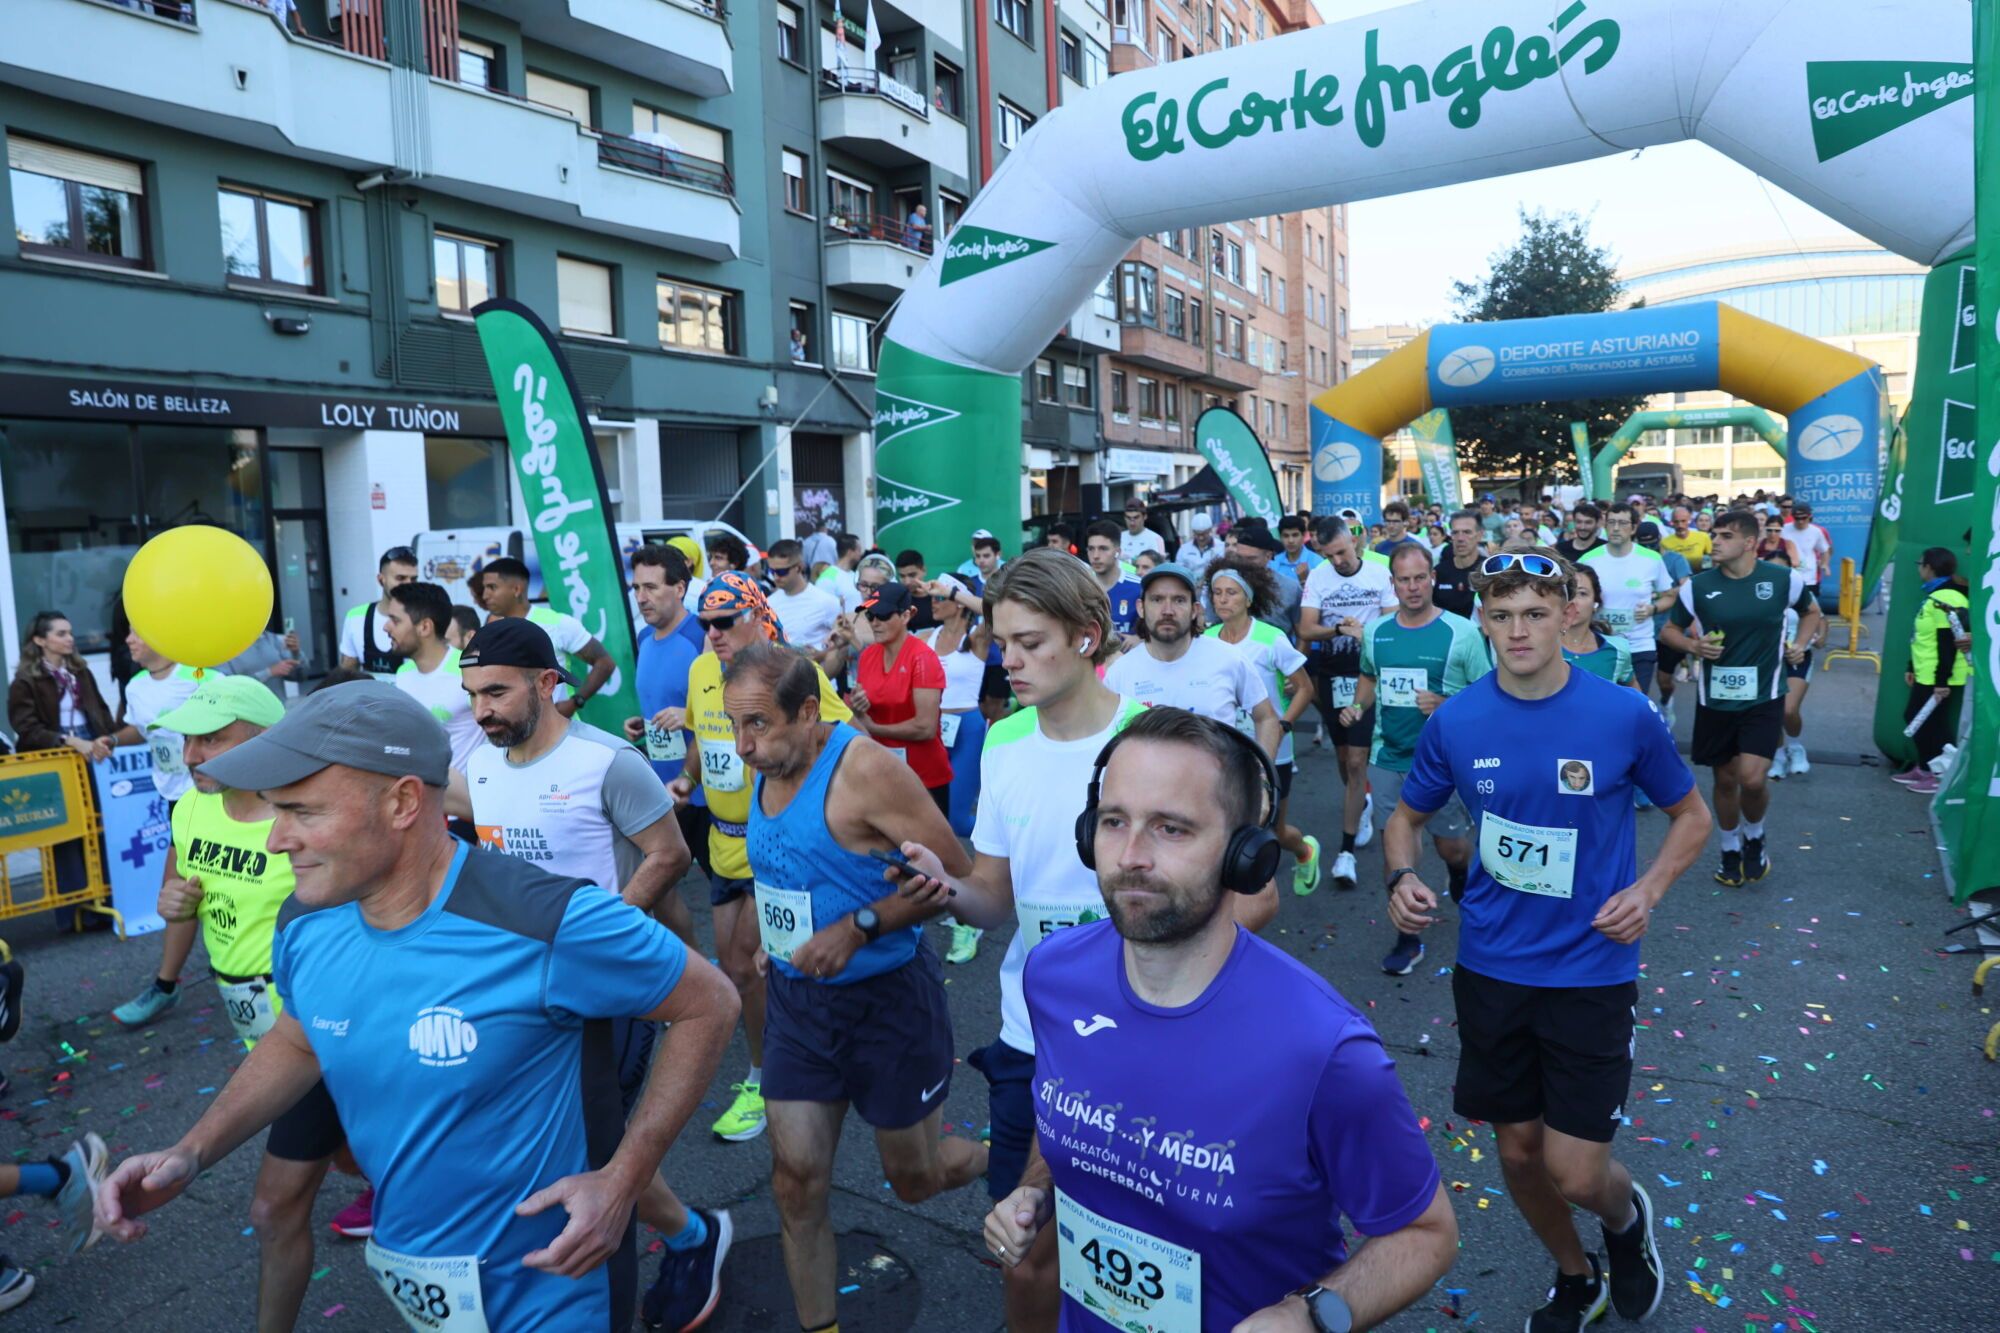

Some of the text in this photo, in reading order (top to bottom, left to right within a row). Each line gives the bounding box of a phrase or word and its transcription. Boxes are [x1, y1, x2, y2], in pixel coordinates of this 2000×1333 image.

[1121, 0, 1621, 162] El Corte Inglés
[1812, 69, 1974, 120] El Corte Inglé
[956, 241, 982, 258] Corte
[982, 236, 1030, 260] Inglés
[1500, 330, 1700, 362] DEPORTE ASTURIANO
[1551, 364, 1569, 374] DEL
[1628, 358, 1641, 369] DE
[1644, 353, 1696, 367] ASTURIAS
[69, 388, 231, 414] SALÓN DE BELLEZA
[321, 402, 460, 431] LOLY TUÑON
[1794, 473, 1873, 489] DEPORTE
[1388, 677, 1415, 691] 471
[1718, 674, 1747, 687] 498
[648, 730, 672, 744] 554
[703, 751, 731, 771] 312
[1472, 757, 1501, 769] JAKO
[1476, 779, 1495, 795] 69
[15, 806, 59, 826] RURAL
[506, 828, 544, 838] TRAIL
[507, 840, 548, 850] VALLE
[1497, 835, 1549, 867] 571
[209, 908, 237, 931] MOM
[764, 901, 796, 932] 569
[1039, 903, 1072, 912] MARATÓN
[408, 1013, 478, 1059] MMVO
[1040, 1081, 1054, 1104] 21
[1055, 1091, 1116, 1133] LUNAS
[1158, 1136, 1236, 1175] MEDIA
[1035, 1114, 1056, 1141] MEDIA
[1060, 1134, 1121, 1167] MARATÓN
[1071, 1156, 1165, 1206] PONFERRADA
[1061, 1198, 1085, 1220] MEDIA
[1085, 1214, 1134, 1242] MARATÓN
[1135, 1237, 1149, 1248] DE
[1080, 1237, 1165, 1300] 493
[1168, 1257, 1190, 1271] 2025
[384, 1269, 451, 1320] 238
